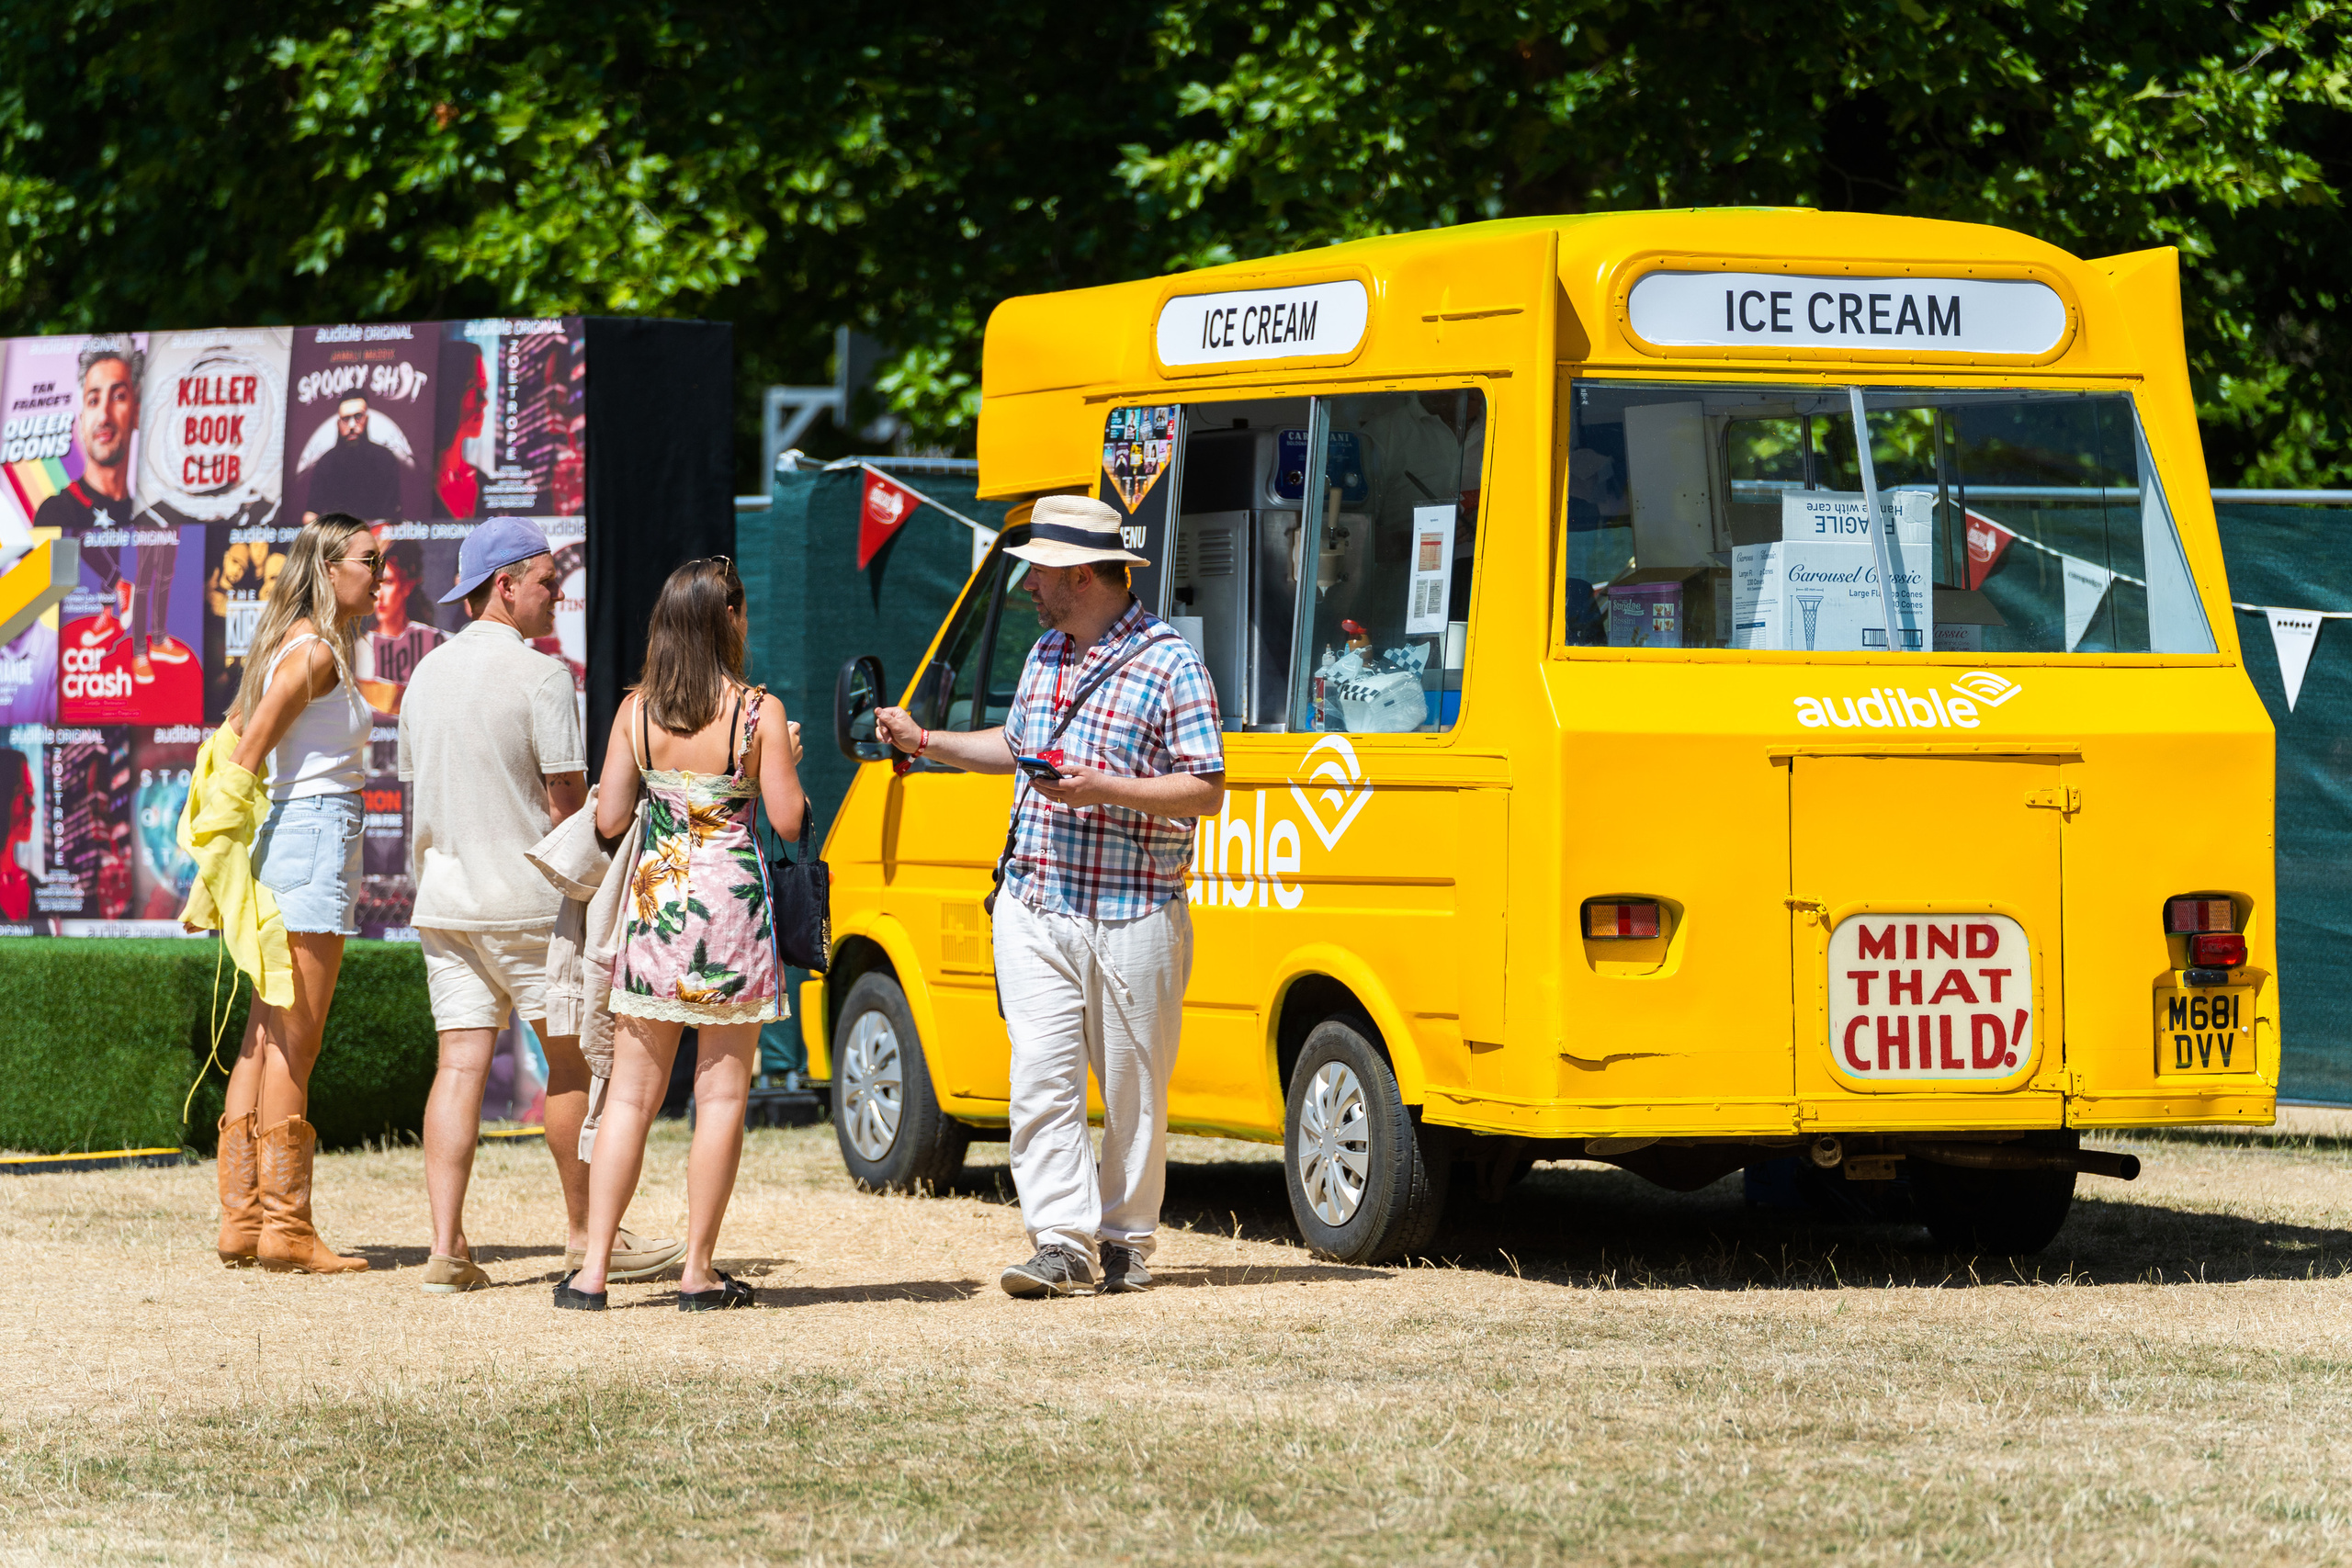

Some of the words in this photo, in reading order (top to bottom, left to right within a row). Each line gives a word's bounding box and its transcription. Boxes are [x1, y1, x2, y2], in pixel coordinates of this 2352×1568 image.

[1201, 307, 1238, 349] ICE
[1242, 299, 1319, 346] CREAM
[1724, 289, 1793, 333] ICE
[1806, 291, 1962, 337] CREAM
[315, 323, 363, 343] audible
[364, 324, 414, 341] ORIGINAL
[463, 320, 512, 337] audible
[513, 319, 566, 335] ORIGINAL
[172, 332, 216, 350] audible
[31, 382, 56, 395] TAN
[176, 375, 258, 408] KILLER
[298, 364, 369, 405] SPOOKY
[13, 393, 73, 412] FRANCE'S
[3, 412, 75, 441] QUEER
[184, 413, 245, 446] BOOK
[0, 433, 73, 463] ICONS
[183, 455, 241, 486] CLUB
[1806, 502, 1832, 512] care
[1834, 503, 1860, 515] with
[230, 525, 277, 544] audible
[379, 521, 430, 541] audible
[1815, 514, 1895, 536] FAGILE
[83, 530, 130, 548] audible
[130, 531, 181, 547] ORIGINAL
[1788, 563, 1864, 584] Carousel
[226, 589, 257, 600] THE
[1849, 589, 1870, 599] Large
[1871, 589, 1882, 598] Fla
[1891, 591, 1900, 600] op
[1901, 590, 1924, 599] Cones
[1901, 600, 1924, 609] Cones
[1612, 616, 1636, 626] Rossini
[62, 648, 107, 672] car
[62, 665, 132, 698] crash
[1792, 687, 1982, 728] audible
[9, 728, 55, 746] audible
[55, 728, 106, 745] ORIGINAL
[153, 725, 201, 744] audible
[1188, 789, 1305, 909] ible
[1858, 923, 2000, 960] MIND
[1847, 968, 2012, 1006] THAT
[2168, 995, 2239, 1031] M681
[1843, 1008, 2029, 1071] CHILD!
[2174, 1032, 2233, 1069] DVV
